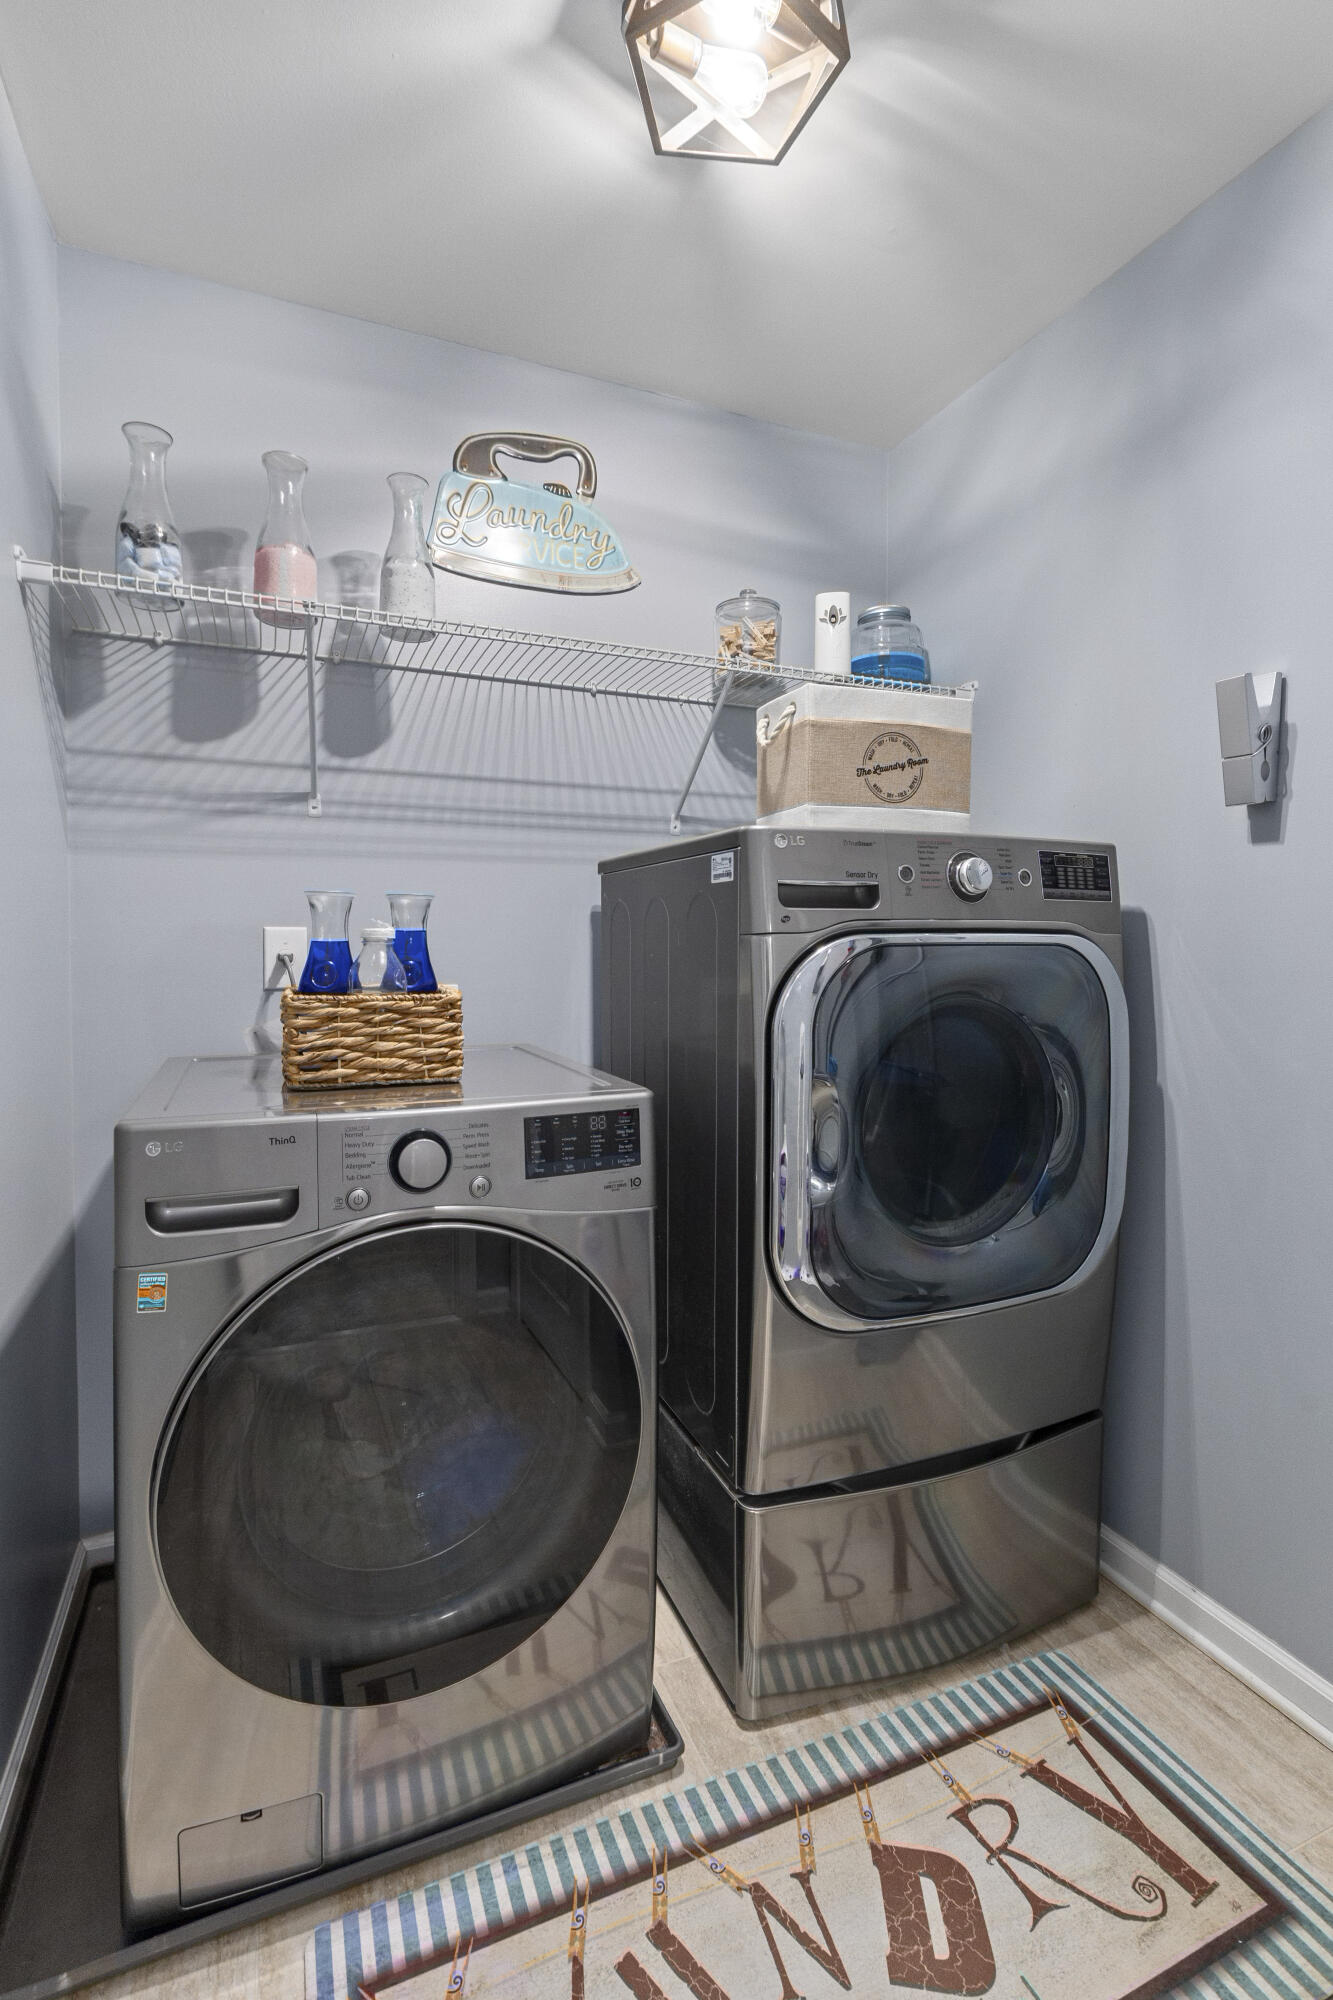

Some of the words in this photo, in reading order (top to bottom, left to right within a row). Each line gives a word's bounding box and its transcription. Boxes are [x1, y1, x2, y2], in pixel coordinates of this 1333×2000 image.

[436, 481, 616, 571] Laundry
[518, 533, 585, 568] RVICE
[856, 767, 872, 777] The
[872, 761, 906, 775] Laundry
[906, 757, 929, 769] Room
[790, 835, 806, 846] LG
[867, 871, 879, 879] Dry
[268, 1135, 297, 1146] ThinQ
[165, 1141, 183, 1153] LG
